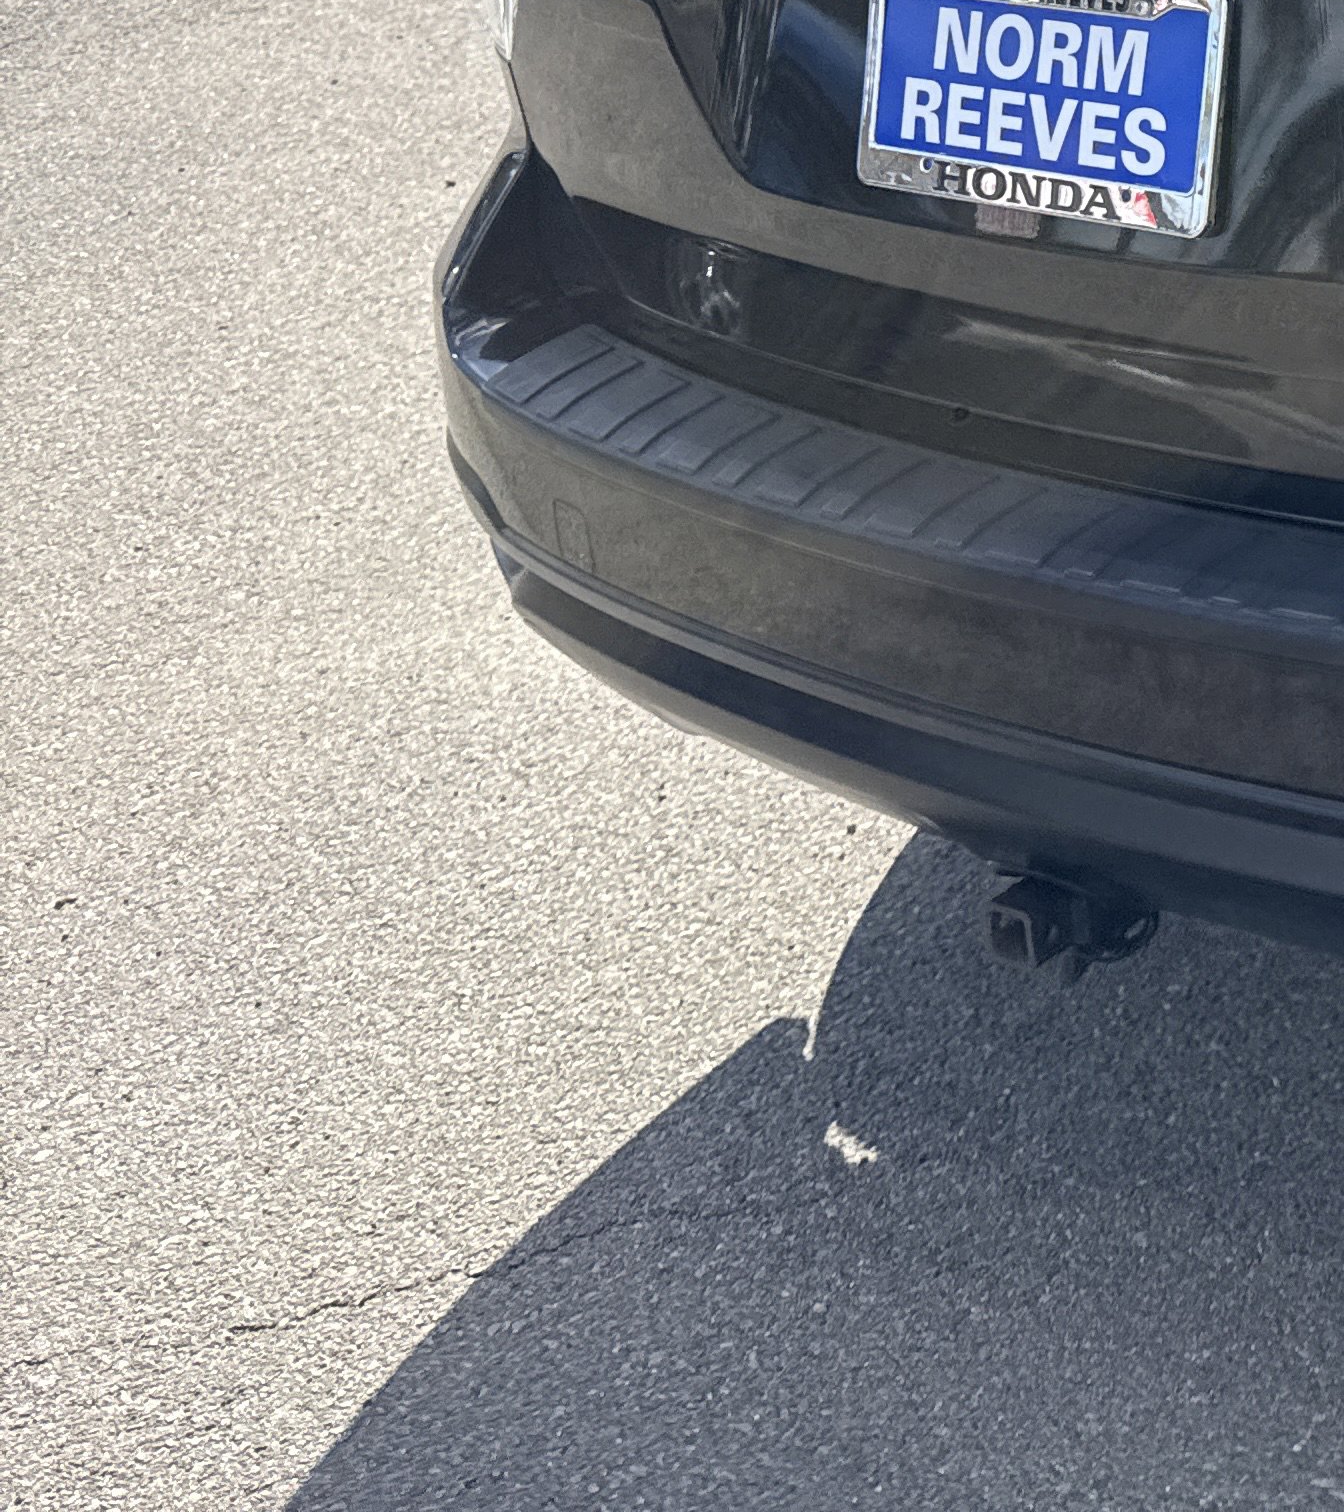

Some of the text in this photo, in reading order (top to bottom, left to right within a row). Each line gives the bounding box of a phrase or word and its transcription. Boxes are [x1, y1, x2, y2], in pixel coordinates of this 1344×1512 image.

[933, 6, 1149, 97] NORM
[900, 76, 1168, 177] REEVES
[934, 159, 1122, 220] HONDA
